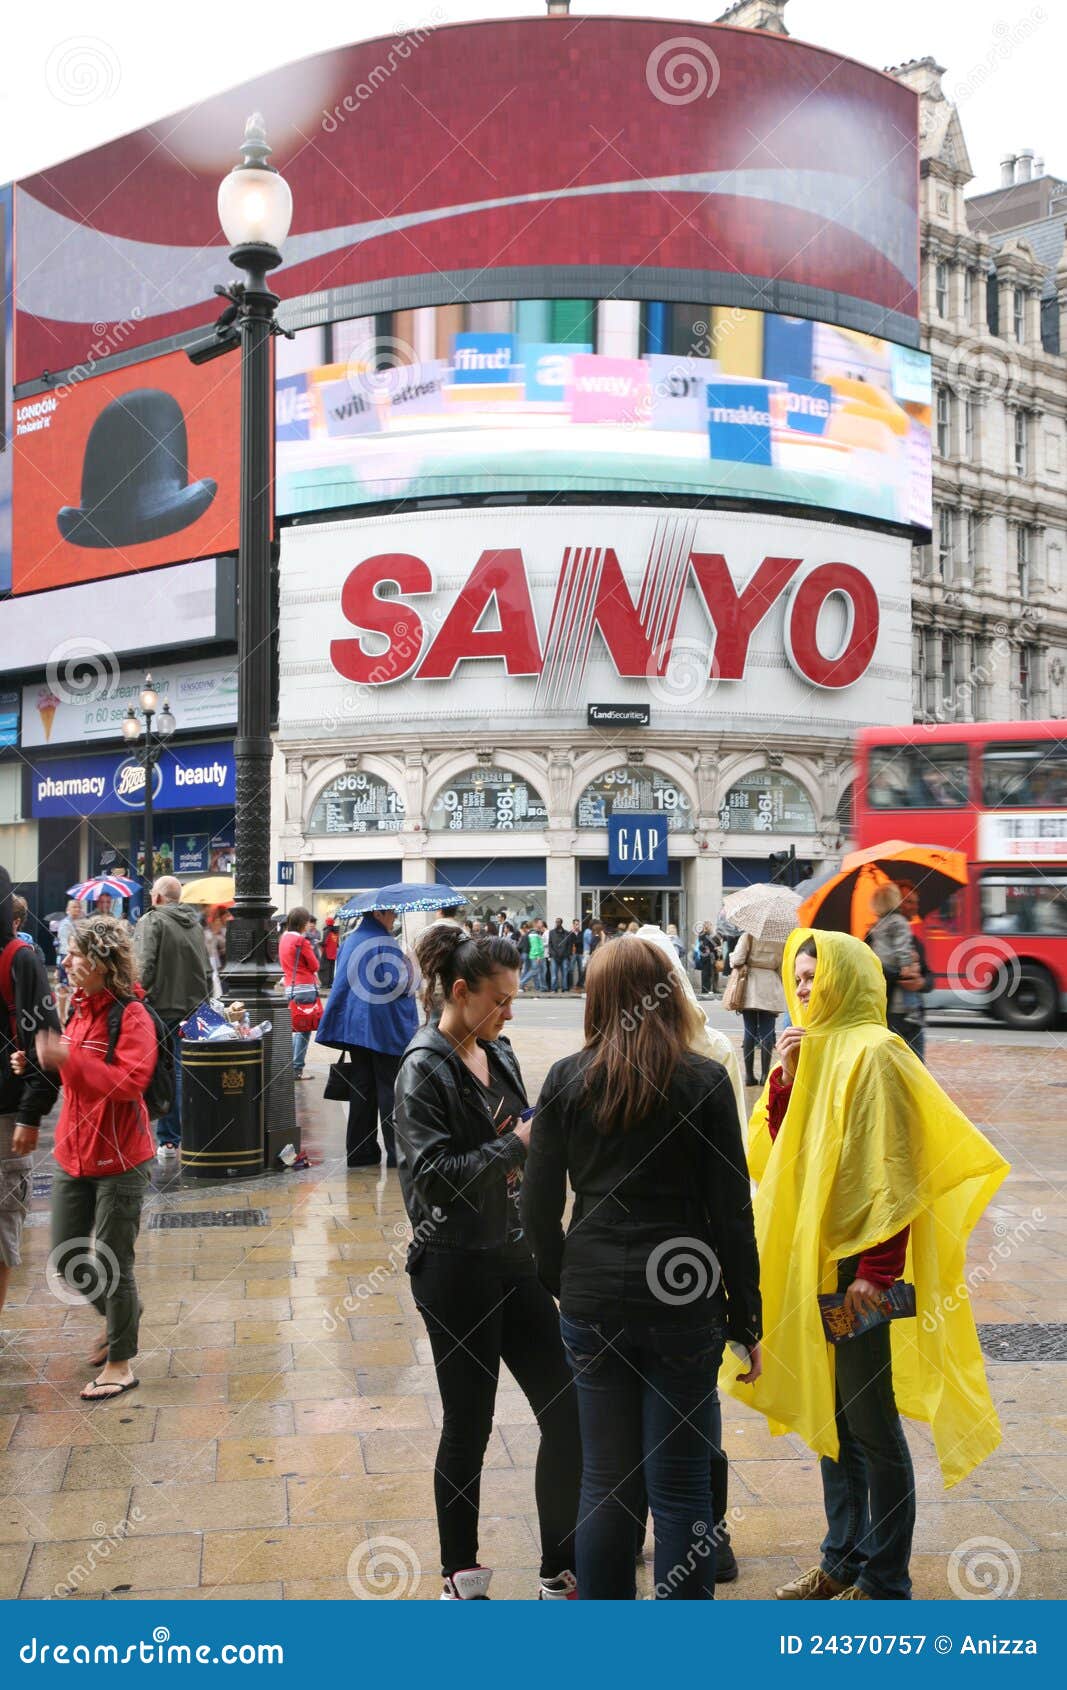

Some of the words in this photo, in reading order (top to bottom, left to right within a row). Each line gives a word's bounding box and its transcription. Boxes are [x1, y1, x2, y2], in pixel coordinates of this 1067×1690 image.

[16, 398, 56, 421] LONDON
[330, 520, 881, 705] SANYO
[592, 709, 646, 721] LandSecurities
[175, 762, 227, 788] beauty
[38, 776, 105, 802] pharmacy
[617, 827, 659, 862] GAP
